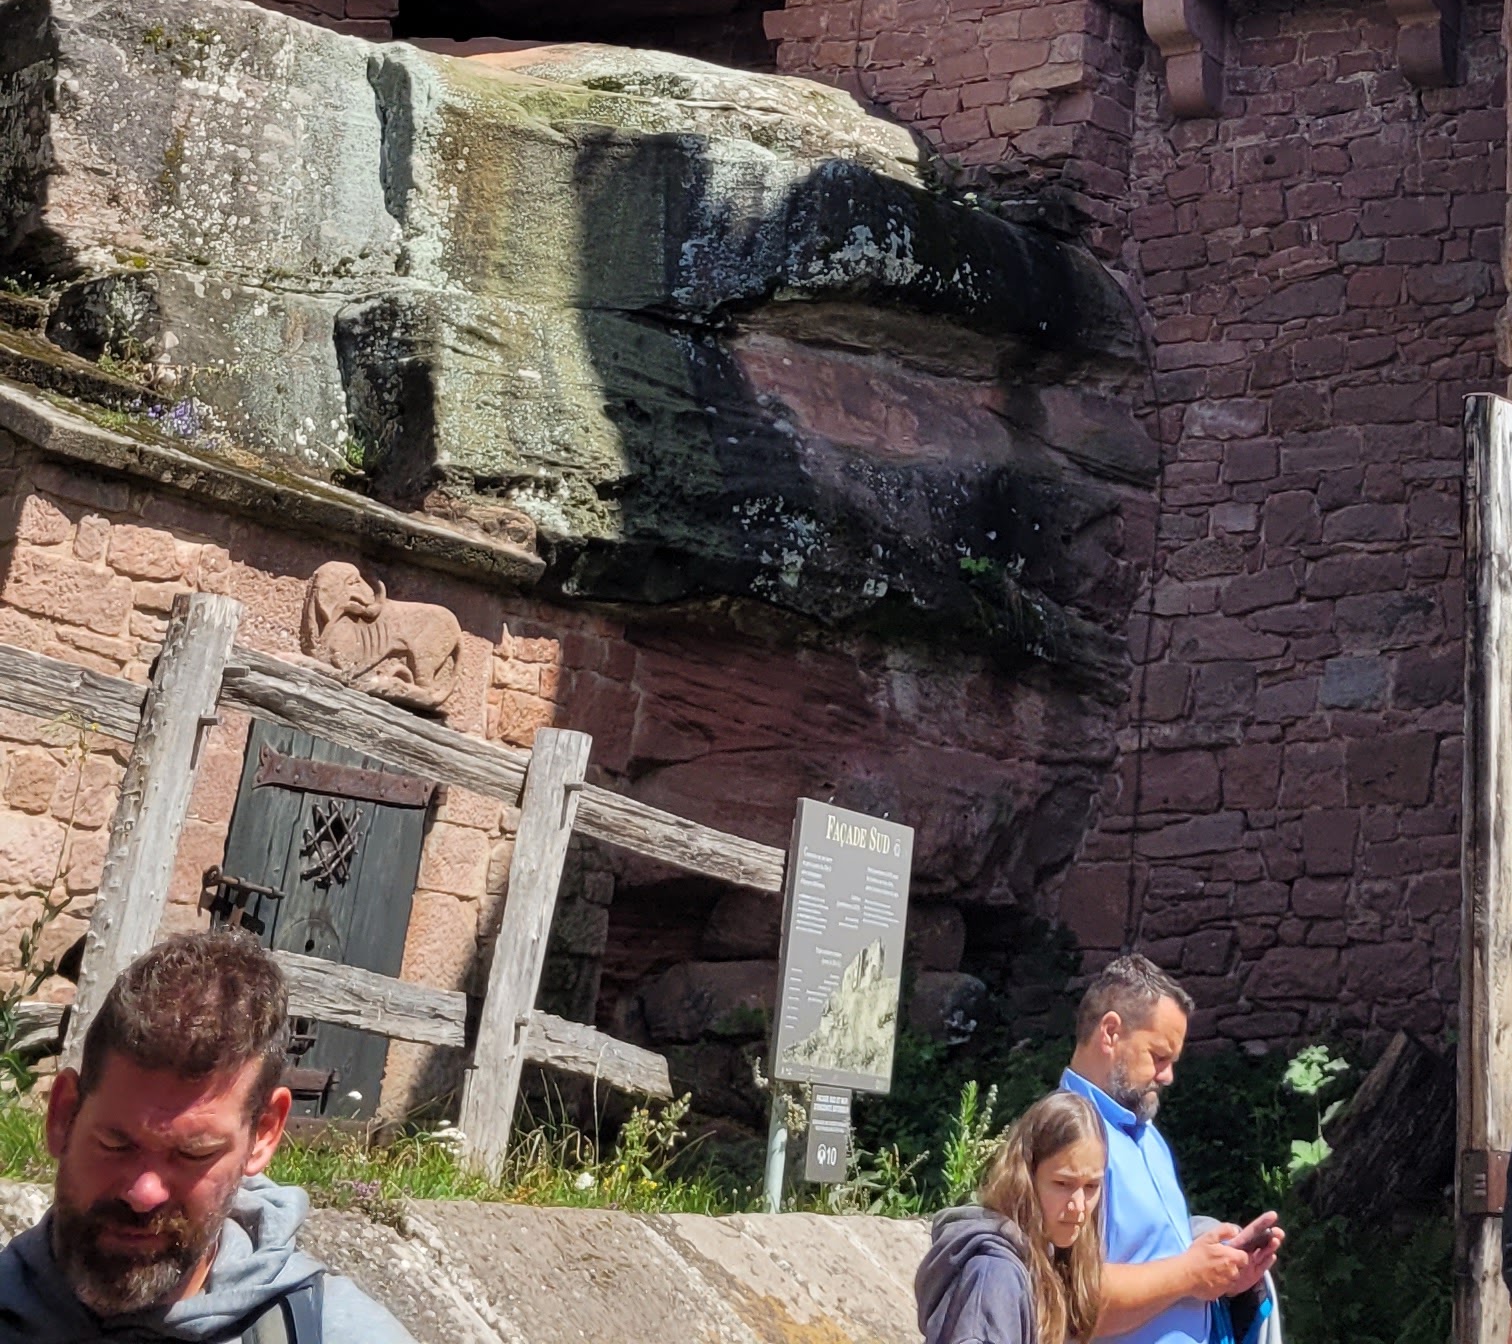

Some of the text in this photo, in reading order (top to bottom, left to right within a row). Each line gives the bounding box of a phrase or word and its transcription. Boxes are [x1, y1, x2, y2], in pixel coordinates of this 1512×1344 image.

[825, 814, 891, 855] FAÇADE SUD
[826, 1145, 838, 1167] 10
